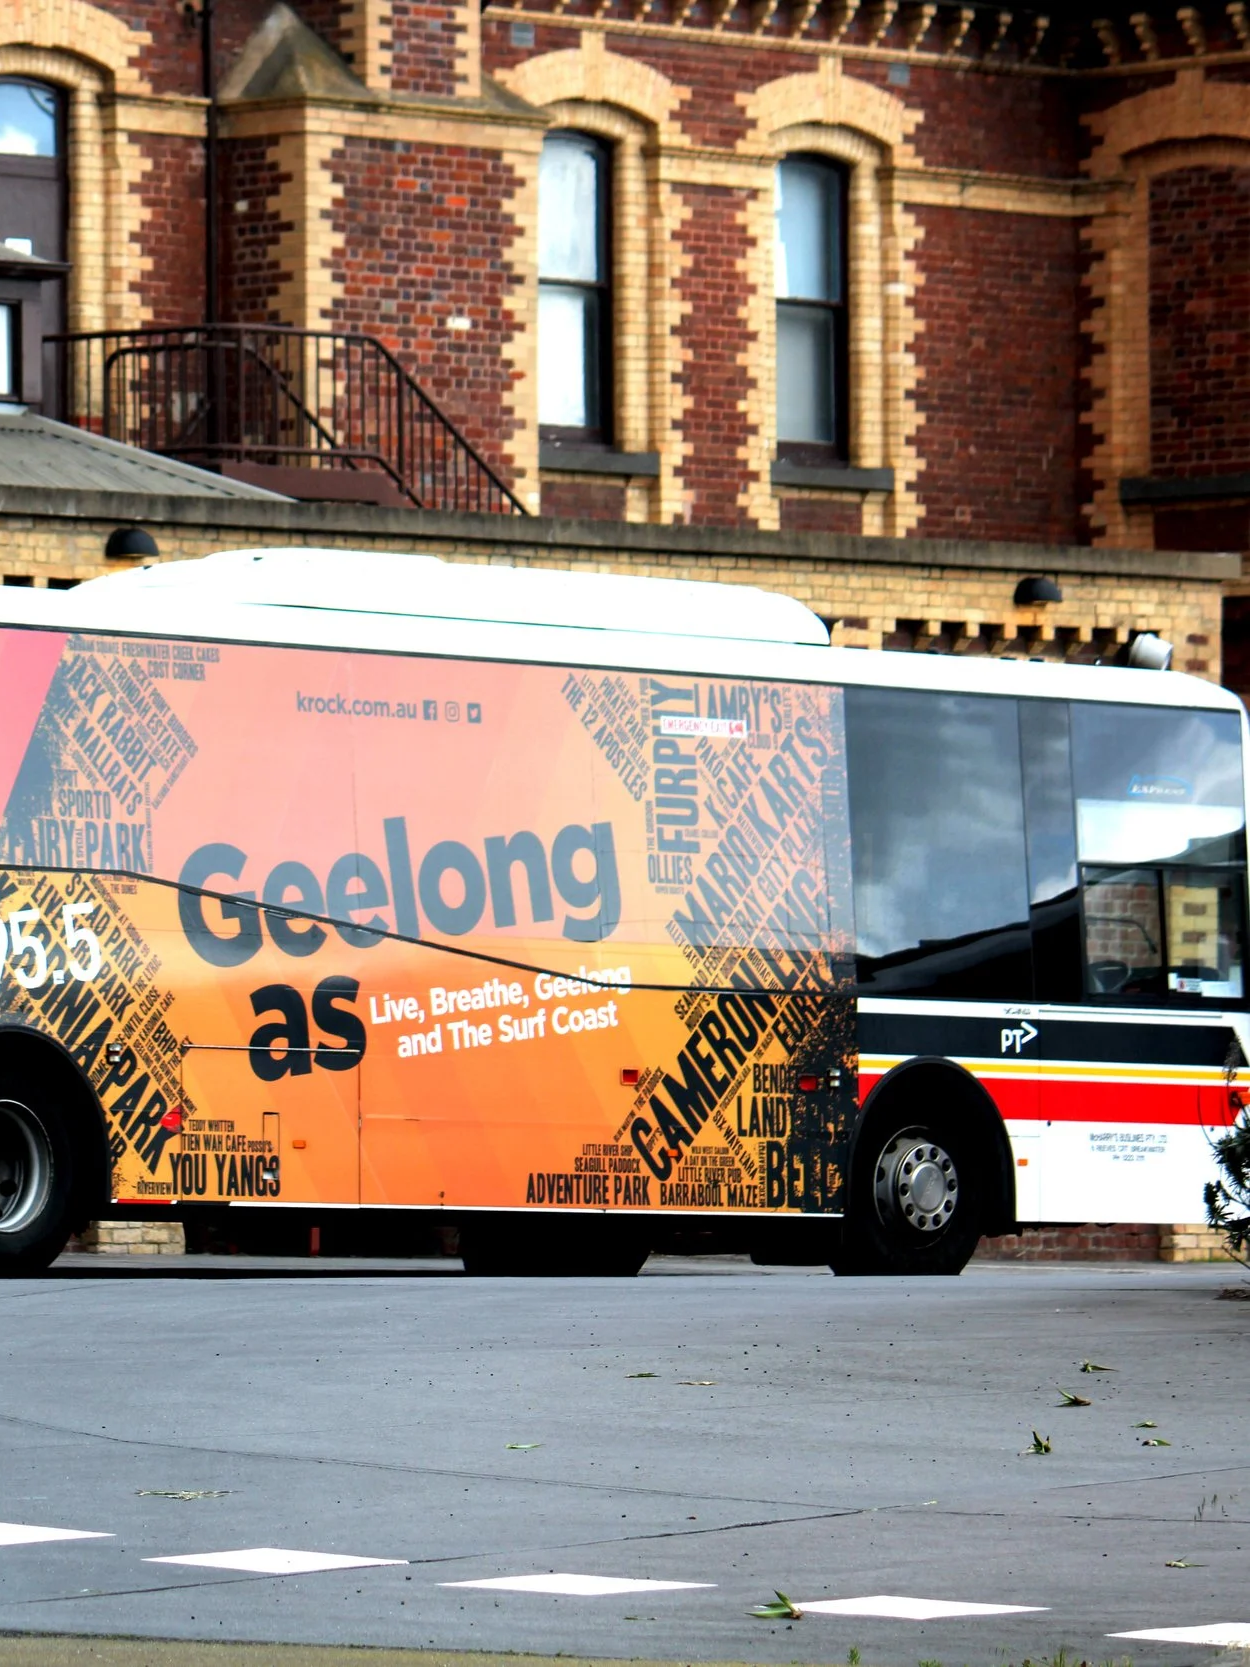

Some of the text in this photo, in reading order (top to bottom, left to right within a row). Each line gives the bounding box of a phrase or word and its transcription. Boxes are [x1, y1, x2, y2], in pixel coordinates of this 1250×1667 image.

[296, 690, 418, 720] krock.com.au
[97, 700, 157, 783] RABBIT
[146, 713, 183, 763] ESTATE
[560, 671, 586, 713] THE
[580, 703, 599, 731] 12
[592, 723, 648, 802] APOSTLES
[625, 714, 649, 749] PARK
[73, 717, 143, 817] MALLRATS
[695, 736, 725, 779] PAKO
[716, 741, 762, 809] CAFE
[58, 789, 112, 820] SPORTO
[84, 820, 151, 873] PARK
[672, 824, 761, 958] MARIO
[742, 716, 829, 848] KARTS
[647, 853, 693, 885] OLLIES
[177, 815, 623, 969] Geelong
[104, 925, 144, 982] PARK
[682, 944, 701, 969] CATS
[92, 961, 135, 1022] PARK
[139, 985, 161, 1016] CLOSE
[369, 964, 632, 1027] Live, Breathe, Geelong
[151, 1020, 178, 1056] BHP
[248, 974, 367, 1083] as
[396, 999, 620, 1060] and The Surf Coast
[630, 957, 780, 1183] CAMERON
[643, 1065, 665, 1099] PADDOCK
[96, 1045, 182, 1176] PARK
[712, 1109, 744, 1155] SIX WAYS
[182, 1133, 247, 1153] TIEN WAH CAFE
[574, 1156, 641, 1173] SEAGULL PADDOCK
[582, 1143, 602, 1156] LITTLE
[168, 1152, 281, 1197] YOU YANGS
[526, 1172, 651, 1206] ADVENTURE PARK
[660, 1183, 758, 1208] BARRABOOL MAZE
[678, 1166, 726, 1183] LITTLE RIVER
